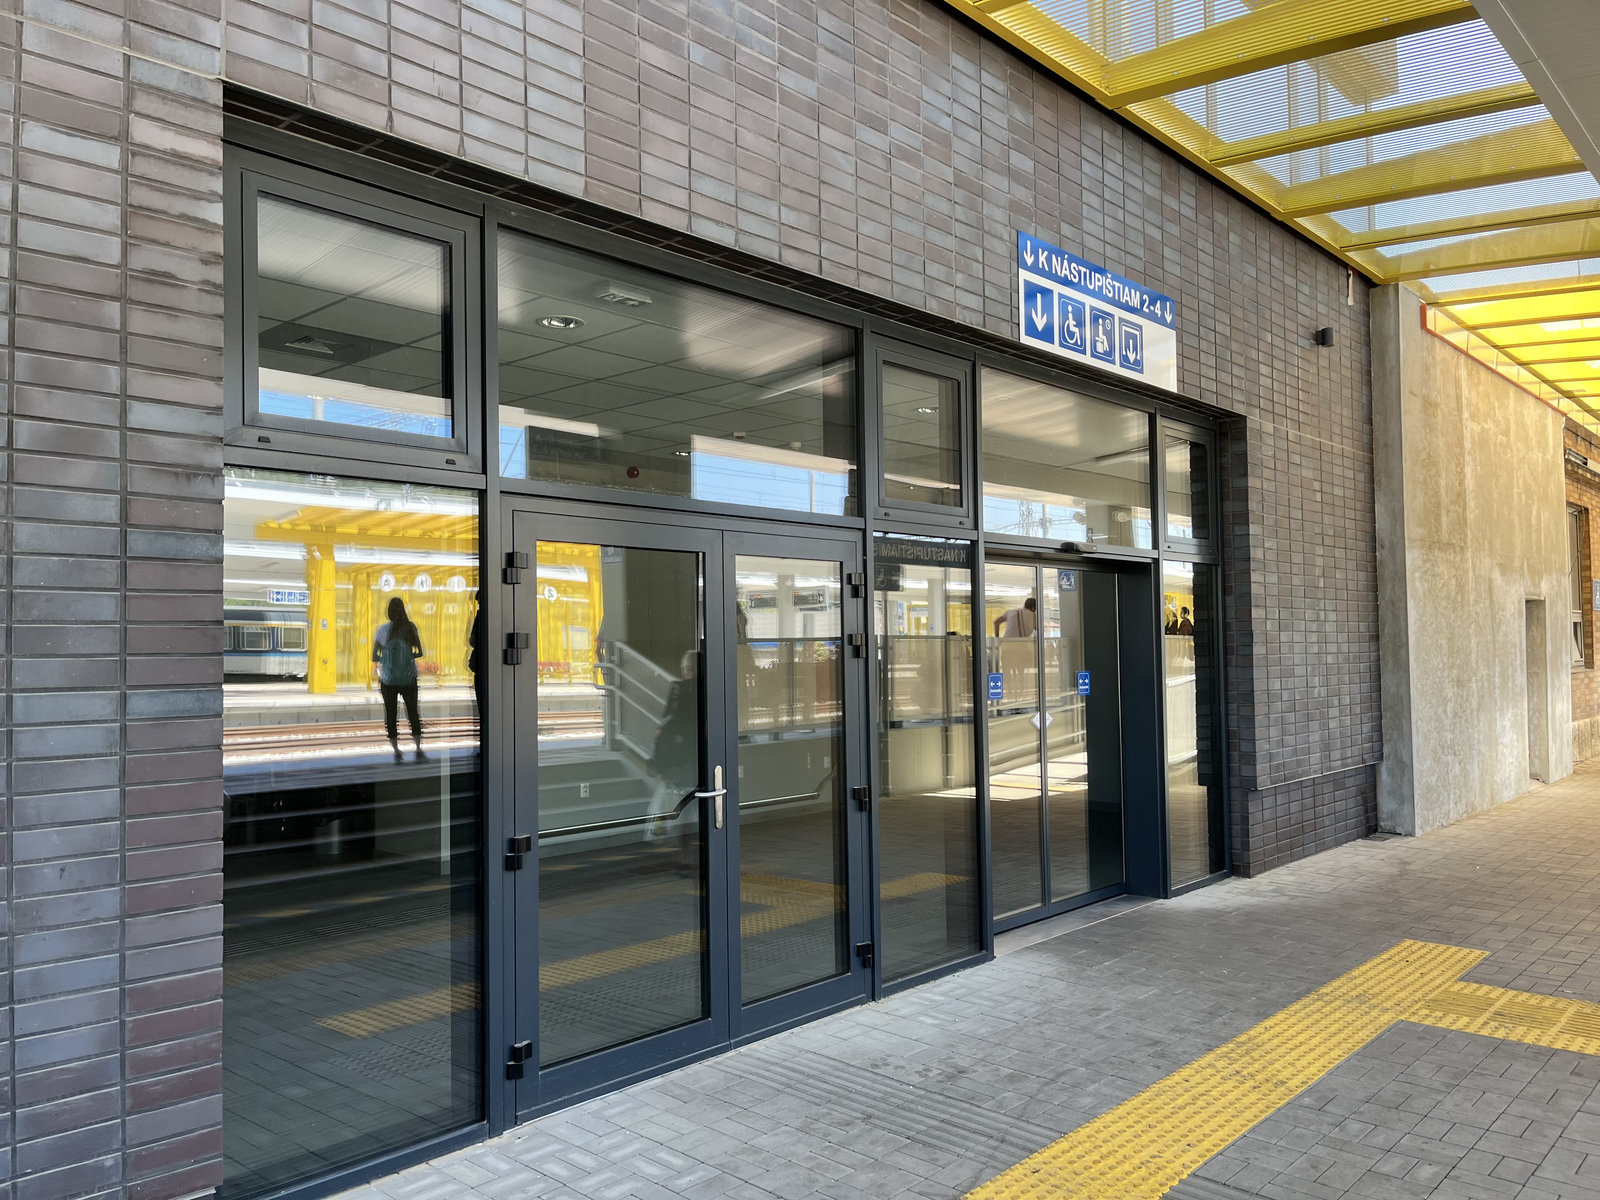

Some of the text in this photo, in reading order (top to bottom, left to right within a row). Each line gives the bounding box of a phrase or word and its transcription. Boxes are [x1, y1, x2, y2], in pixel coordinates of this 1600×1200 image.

[1038, 248, 1161, 317] K NÁSTUPIŠTIAM 2-4
